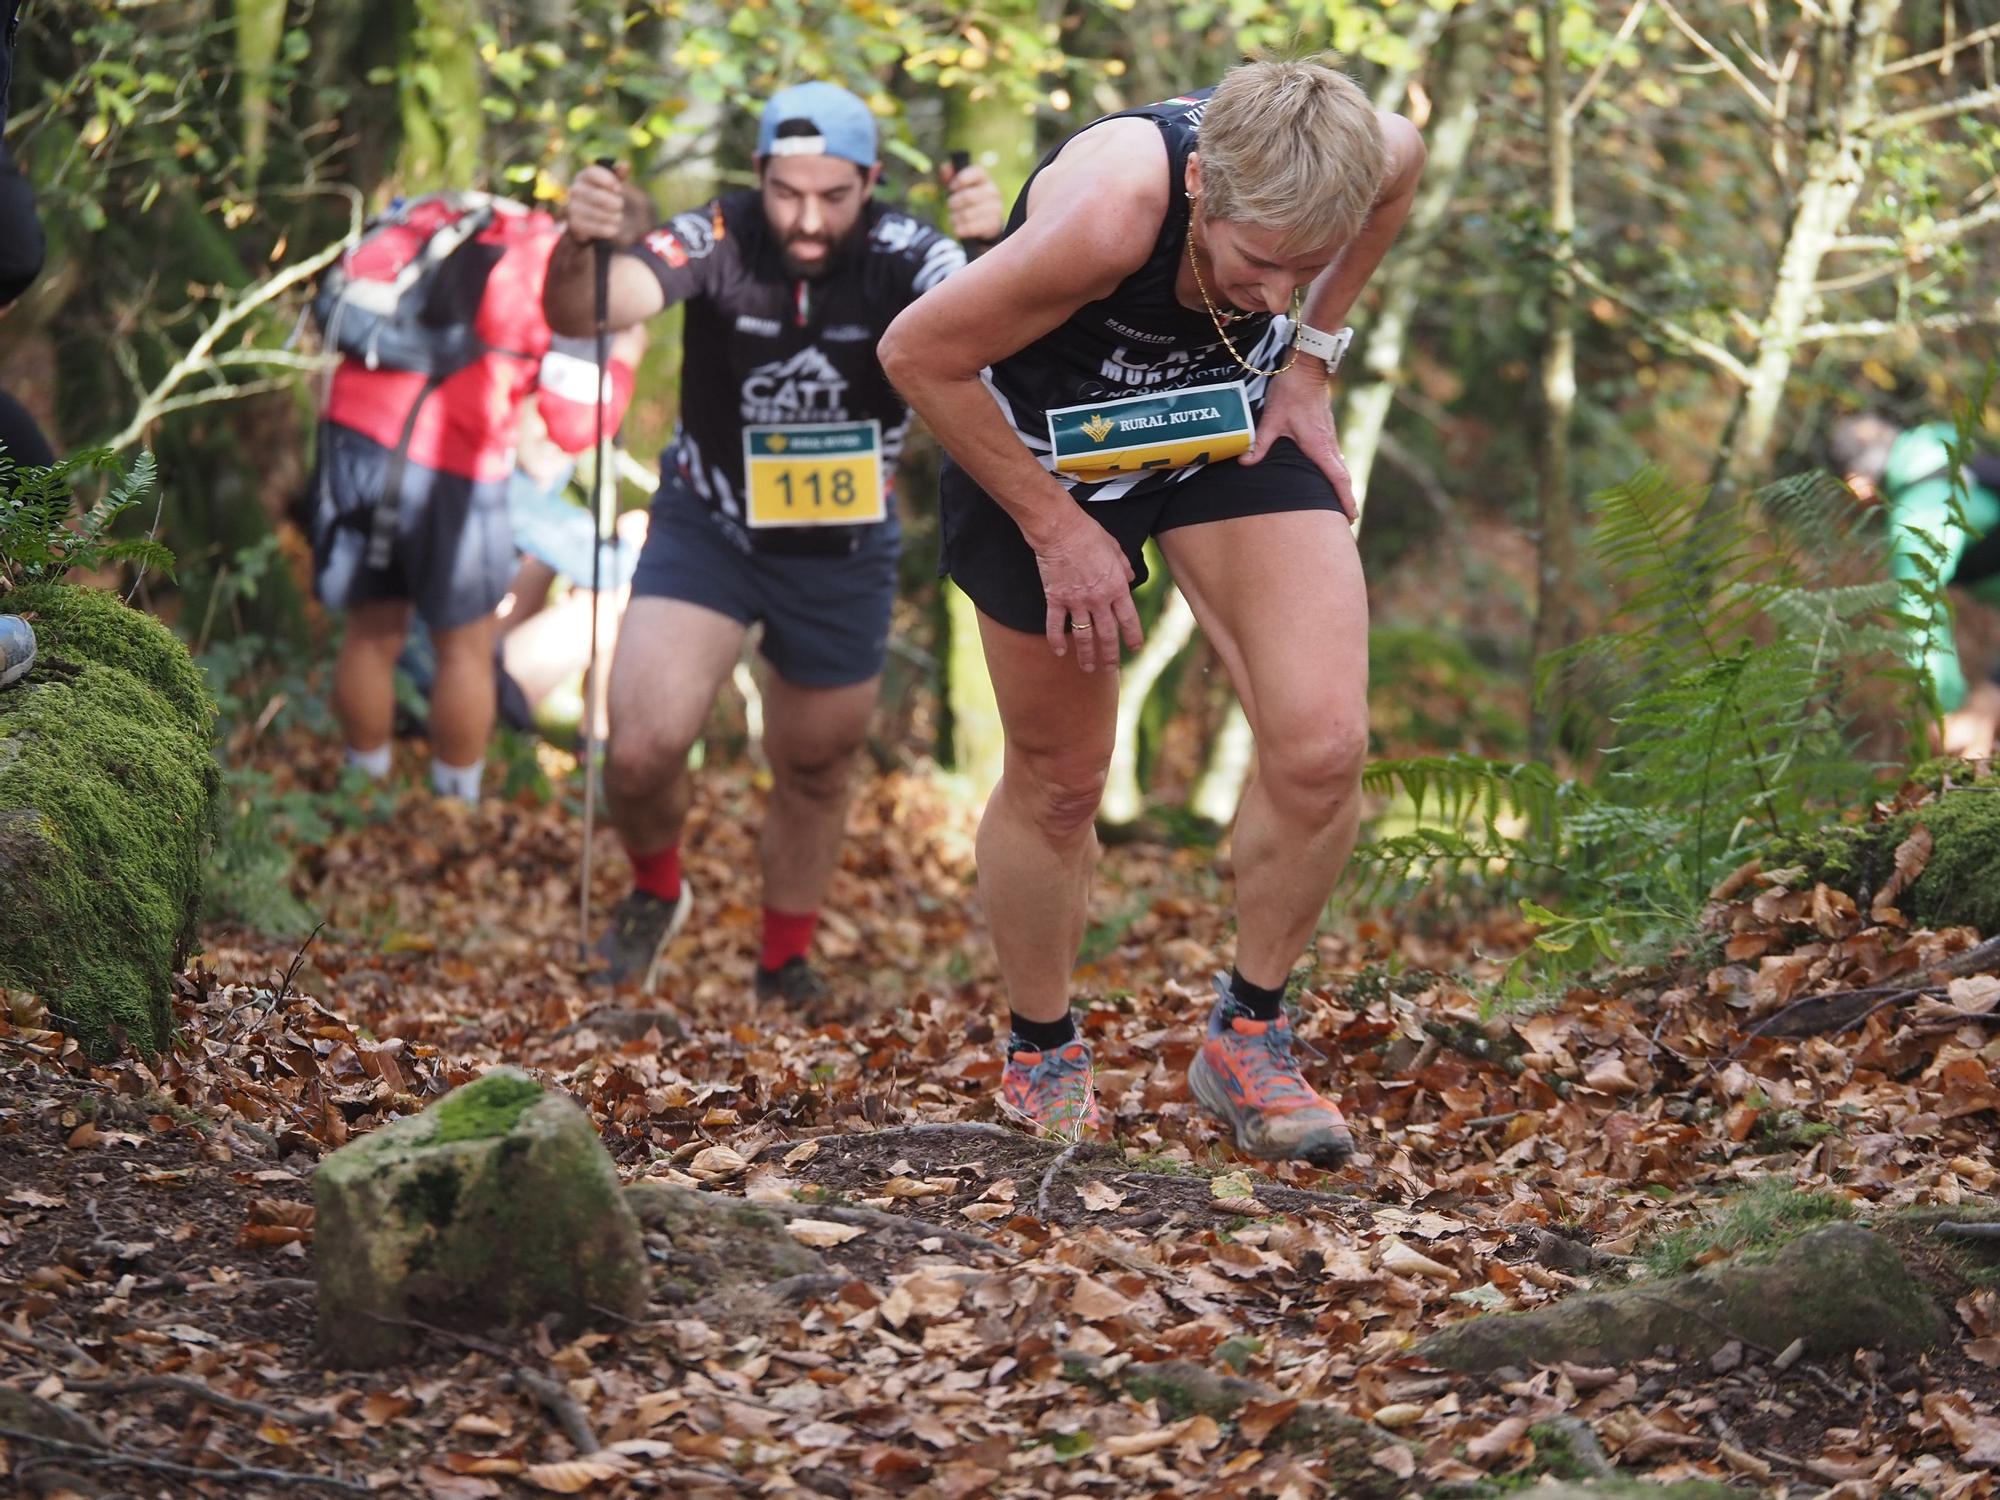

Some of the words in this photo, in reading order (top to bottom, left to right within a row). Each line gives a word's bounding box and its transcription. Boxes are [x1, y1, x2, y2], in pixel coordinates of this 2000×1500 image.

[1120, 416, 1167, 432] RURAL
[1169, 407, 1222, 424] KUTXA
[774, 469, 857, 507] 118
